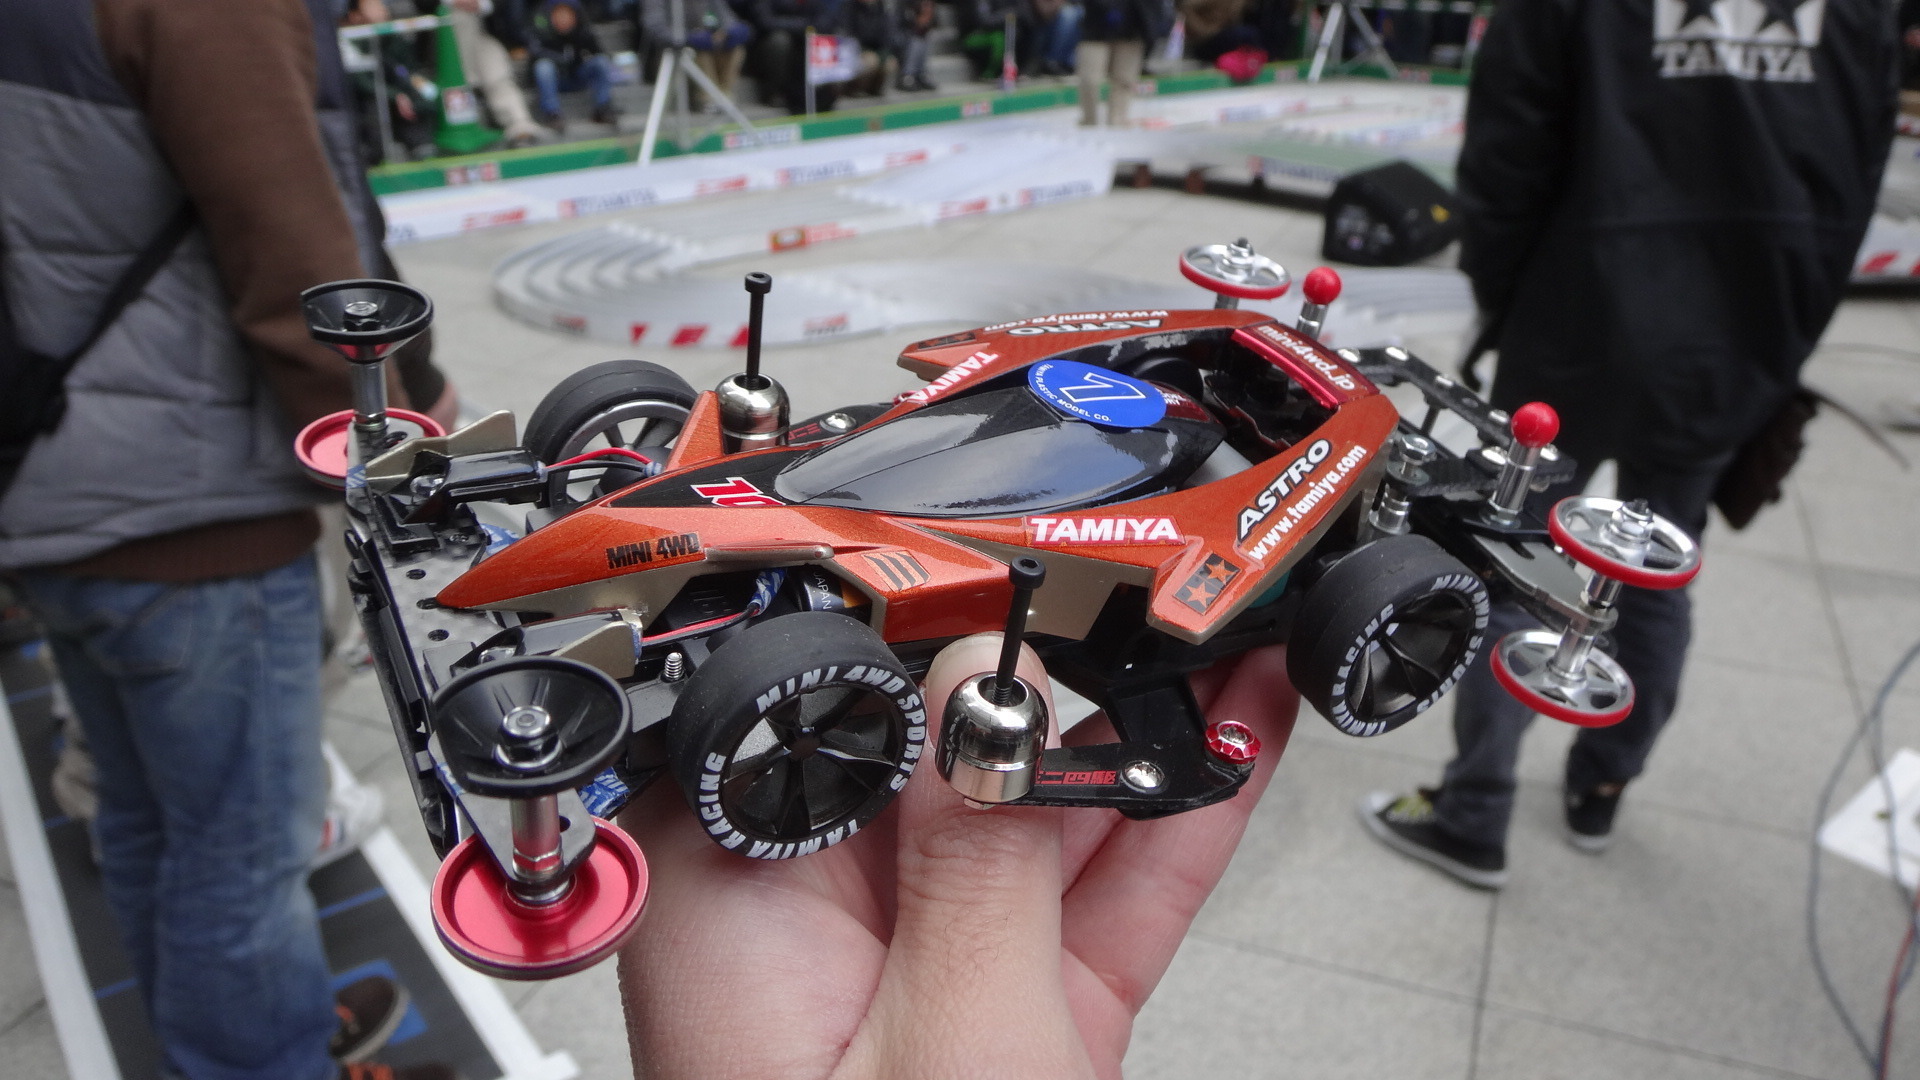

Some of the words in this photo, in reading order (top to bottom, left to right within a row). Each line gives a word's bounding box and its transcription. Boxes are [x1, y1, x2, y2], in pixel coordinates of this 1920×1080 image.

[1652, 40, 1814, 83] TAMIYA
[1008, 319, 1163, 336] ASTRO
[905, 350, 1000, 404] TAMIYA
[1257, 325, 1355, 390] mini4wd.jp
[1036, 376, 1058, 400] PLASTIC
[1057, 399, 1091, 418] MODEL
[1093, 412, 1112, 422] CO.
[1239, 439, 1332, 541] ASTRO
[1249, 445, 1367, 560] www.tamiya.com
[606, 540, 651, 570] MINI
[656, 532, 701, 560] 4WD
[1030, 517, 1179, 543] TAMIYA
[813, 572, 831, 610] JAPAN
[1430, 574, 1480, 594] MINI
[1331, 603, 1394, 697] RACING
[1416, 635, 1484, 716] SPORTS
[756, 666, 838, 714] MINI
[843, 665, 906, 694] 4WD
[889, 693, 926, 793] SPORTS
[699, 752, 746, 852] RACING
[746, 818, 861, 860] TAMIYA
